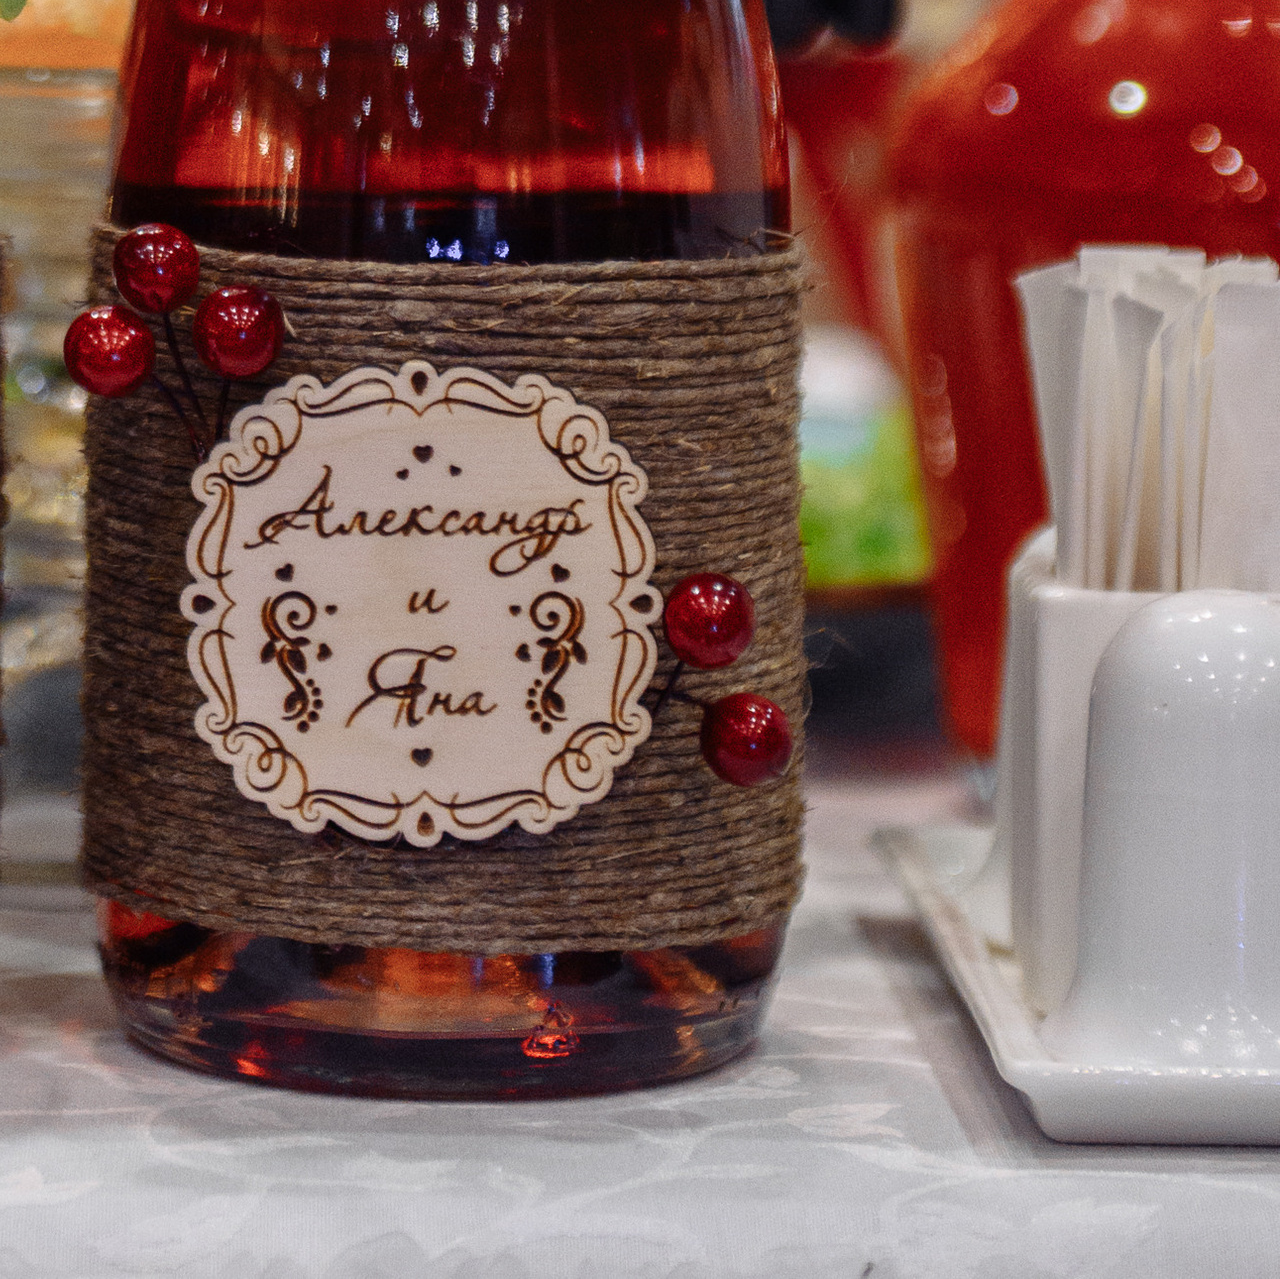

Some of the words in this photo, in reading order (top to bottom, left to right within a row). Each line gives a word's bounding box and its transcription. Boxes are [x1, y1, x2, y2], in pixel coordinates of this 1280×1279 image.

[243, 464, 593, 578] Александр
[407, 587, 450, 615] и
[345, 645, 498, 728] Яна
